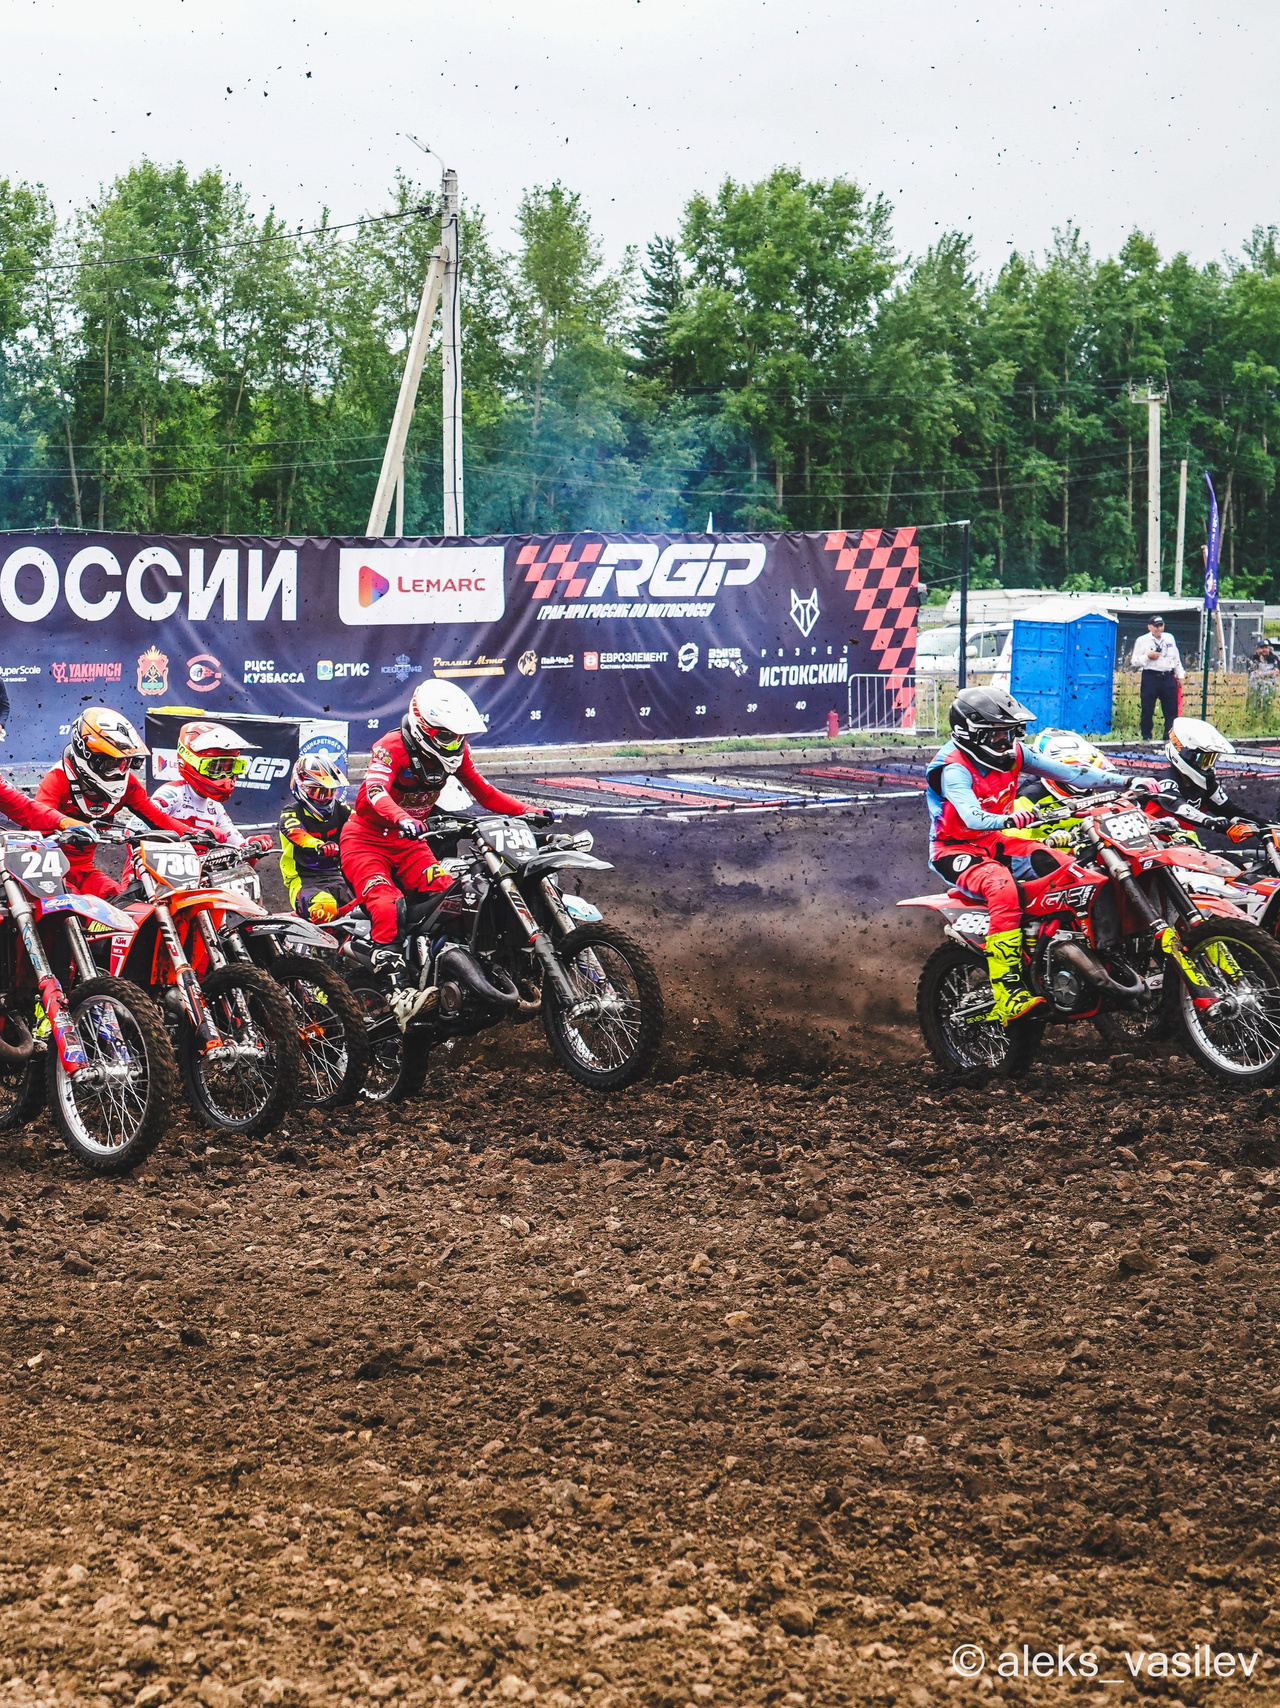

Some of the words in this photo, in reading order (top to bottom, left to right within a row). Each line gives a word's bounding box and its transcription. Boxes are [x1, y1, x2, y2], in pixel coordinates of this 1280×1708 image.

[584, 543, 766, 598] RGP
[397, 575, 486, 593] LEMARC
[537, 604, 588, 620] ГРАН-ПРИ
[629, 603, 648, 618] ПО
[645, 602, 716, 618] МОТОКРОССУ
[600, 651, 669, 663] ЕВРОЭЛЕМЕНТ
[69, 663, 122, 677] YAKHNICH
[244, 660, 275, 671] РЦСС
[334, 662, 369, 677] 2ГИС
[759, 657, 848, 687] ИСТОКСКИЙ
[244, 672, 305, 684] КУЗБАССА
[639, 706, 651, 717] 37
[746, 703, 758, 713] 39
[795, 701, 807, 710] 40
[530, 710, 542, 721] 35
[585, 707, 596, 718] 36
[58, 724, 70, 736] 27
[367, 718, 379, 729] 32
[1076, 793, 1119, 809] RENTHAL
[489, 828, 537, 852] 738
[20, 851, 62, 879] 24
[152, 852, 200, 876] 730
